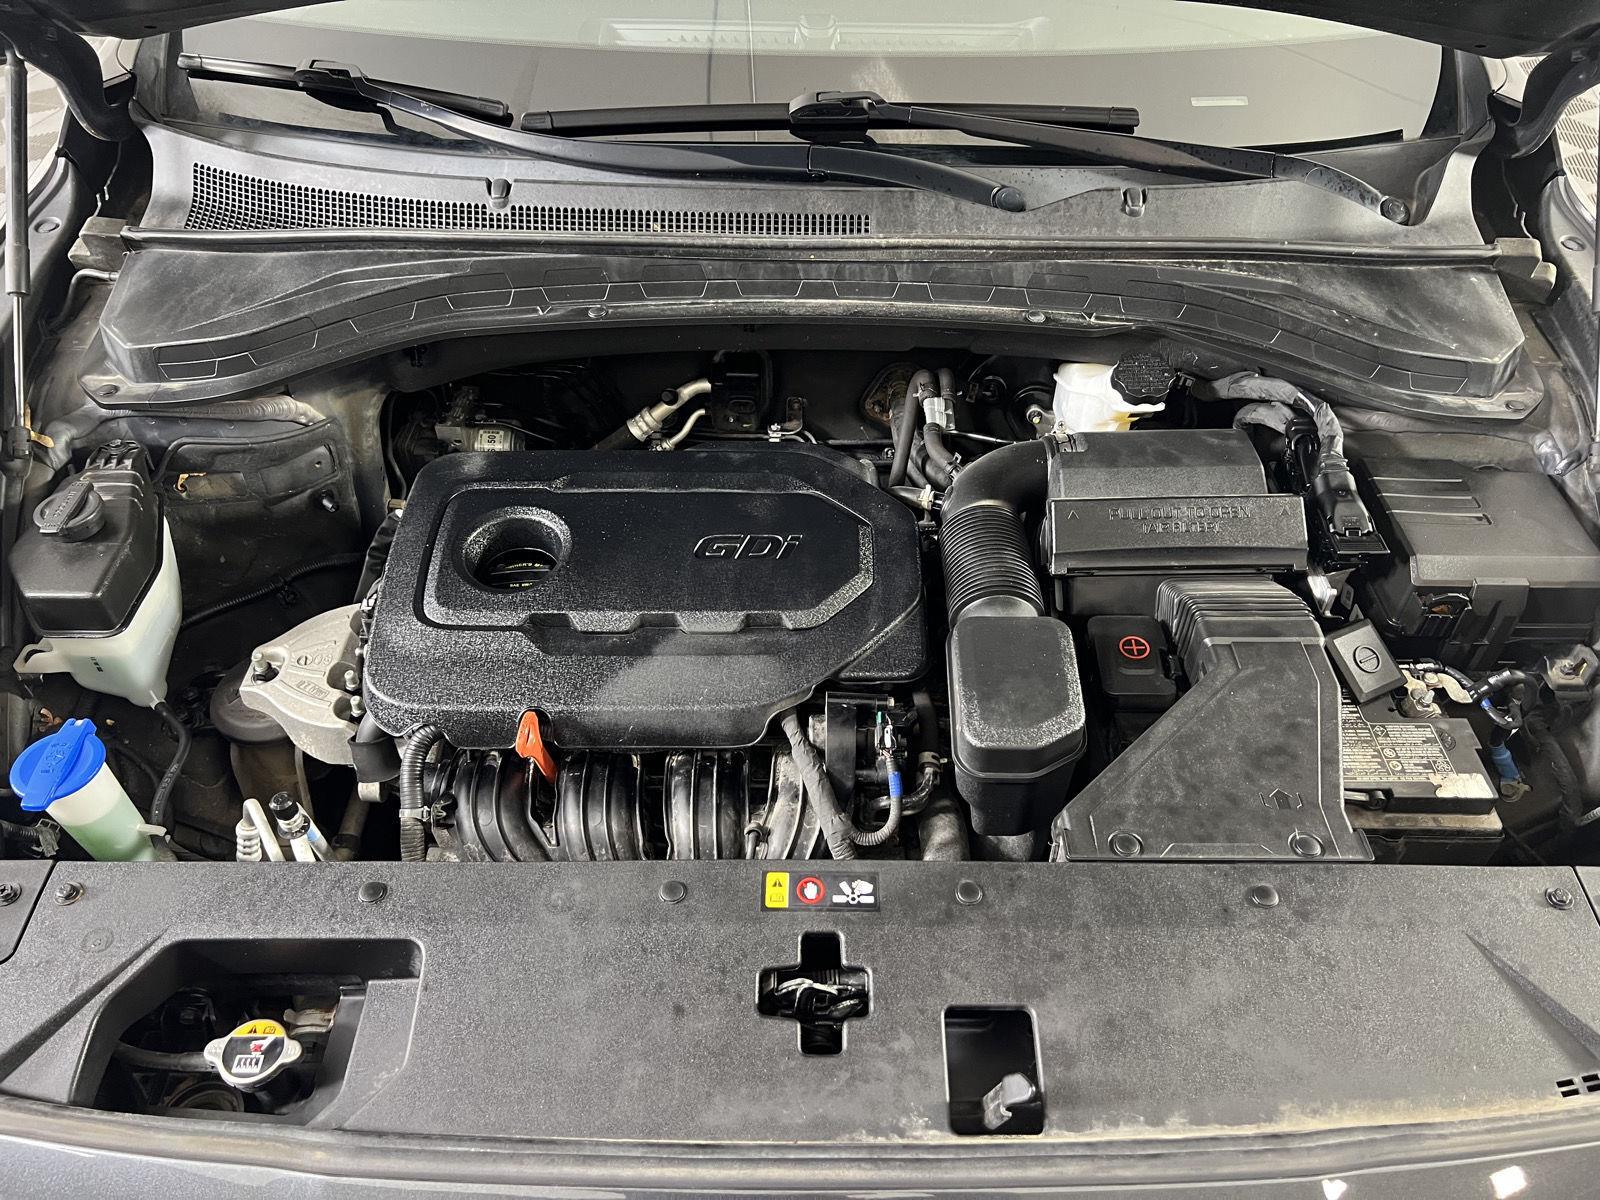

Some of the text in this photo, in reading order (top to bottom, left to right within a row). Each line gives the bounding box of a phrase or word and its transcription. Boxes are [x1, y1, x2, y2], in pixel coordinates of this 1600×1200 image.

[1108, 506, 1251, 520] PULL OUT TO OPEN
[693, 533, 803, 560] GDi
